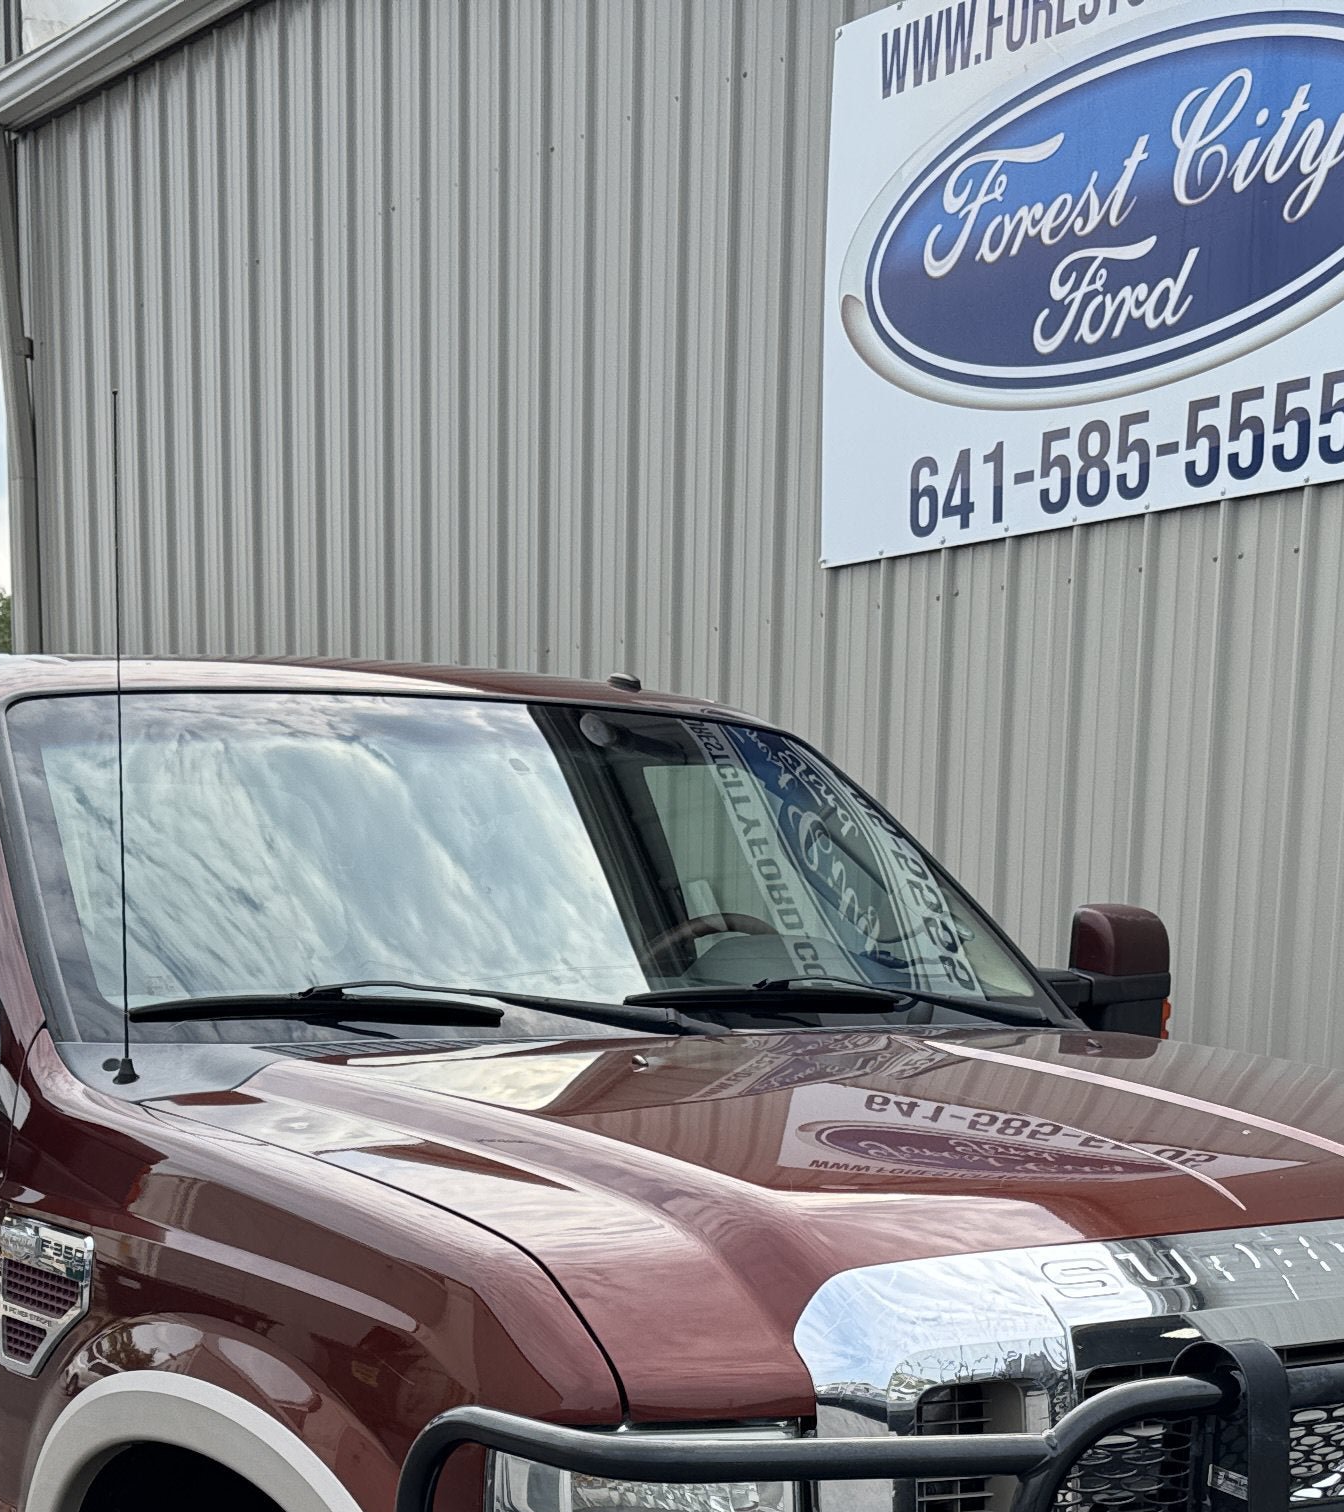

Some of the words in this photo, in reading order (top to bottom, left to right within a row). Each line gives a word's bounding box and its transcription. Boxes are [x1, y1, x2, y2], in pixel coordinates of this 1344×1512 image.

[881, 0, 1145, 99] WWW.FOR
[923, 132, 1149, 278] Forest
[1033, 235, 1200, 355] Ford
[41, 1237, 85, 1262] F-350
